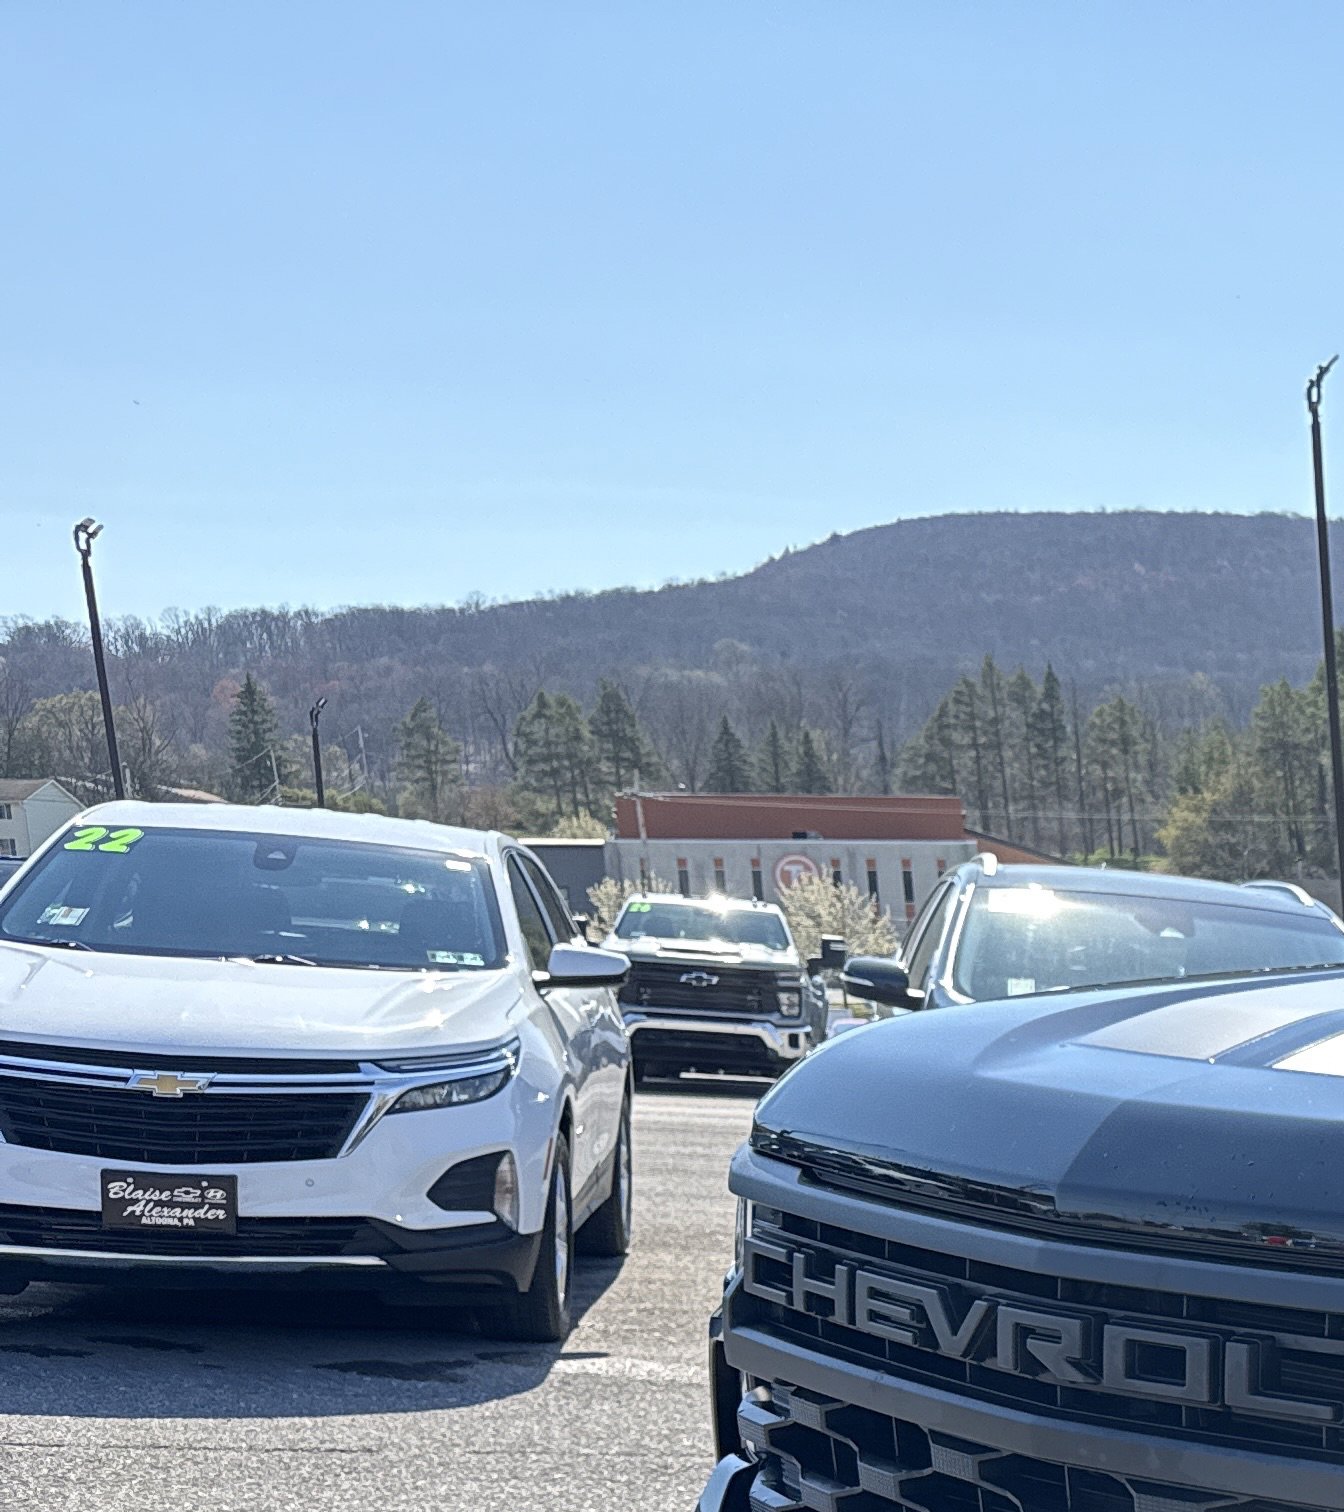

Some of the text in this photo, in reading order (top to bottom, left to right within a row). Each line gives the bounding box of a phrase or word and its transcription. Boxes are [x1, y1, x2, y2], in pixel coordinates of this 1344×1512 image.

[64, 827, 144, 854] 22
[107, 1181, 172, 1202] Blaise
[122, 1199, 227, 1219] Alexander
[182, 1216, 195, 1227] PA
